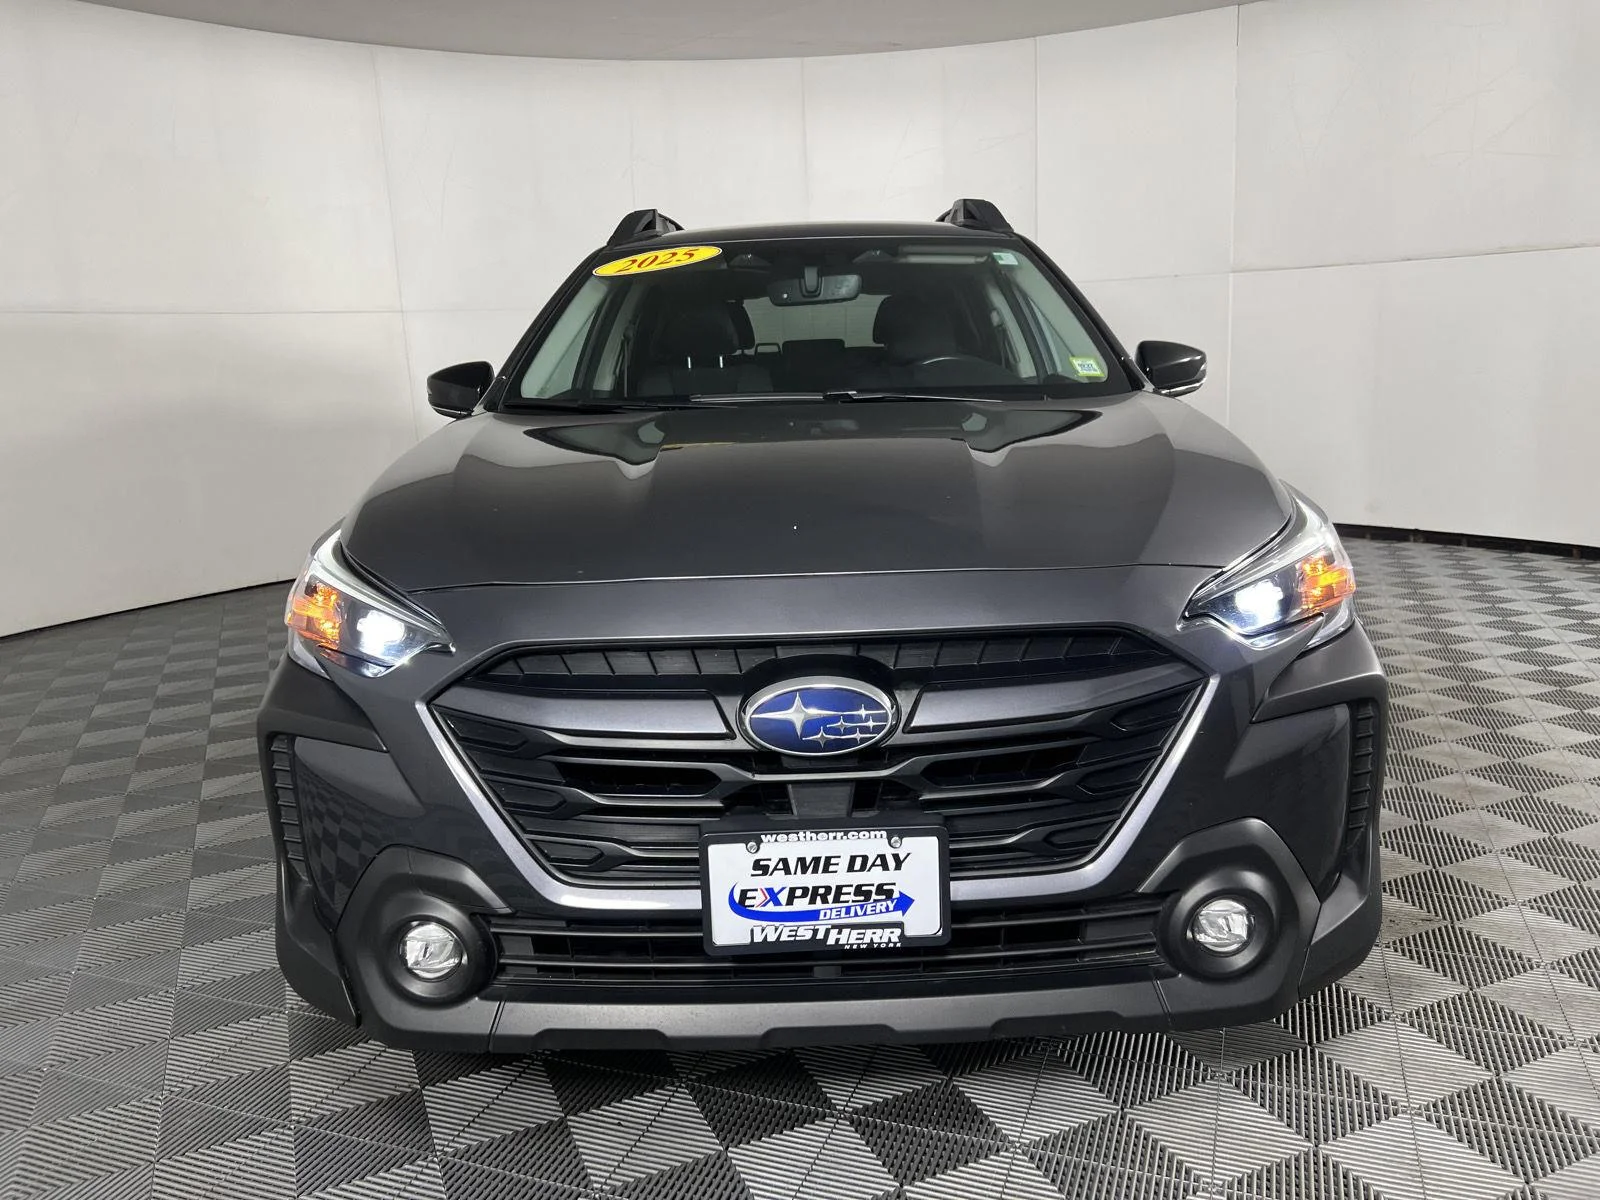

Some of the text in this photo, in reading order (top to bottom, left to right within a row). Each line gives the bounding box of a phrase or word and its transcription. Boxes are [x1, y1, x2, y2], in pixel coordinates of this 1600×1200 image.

[614, 248, 699, 273] 2025
[760, 830, 888, 842] westherr.com
[750, 852, 911, 877] SAME DAY
[738, 882, 896, 908] EXPRESS
[818, 900, 898, 921] DELIVERY
